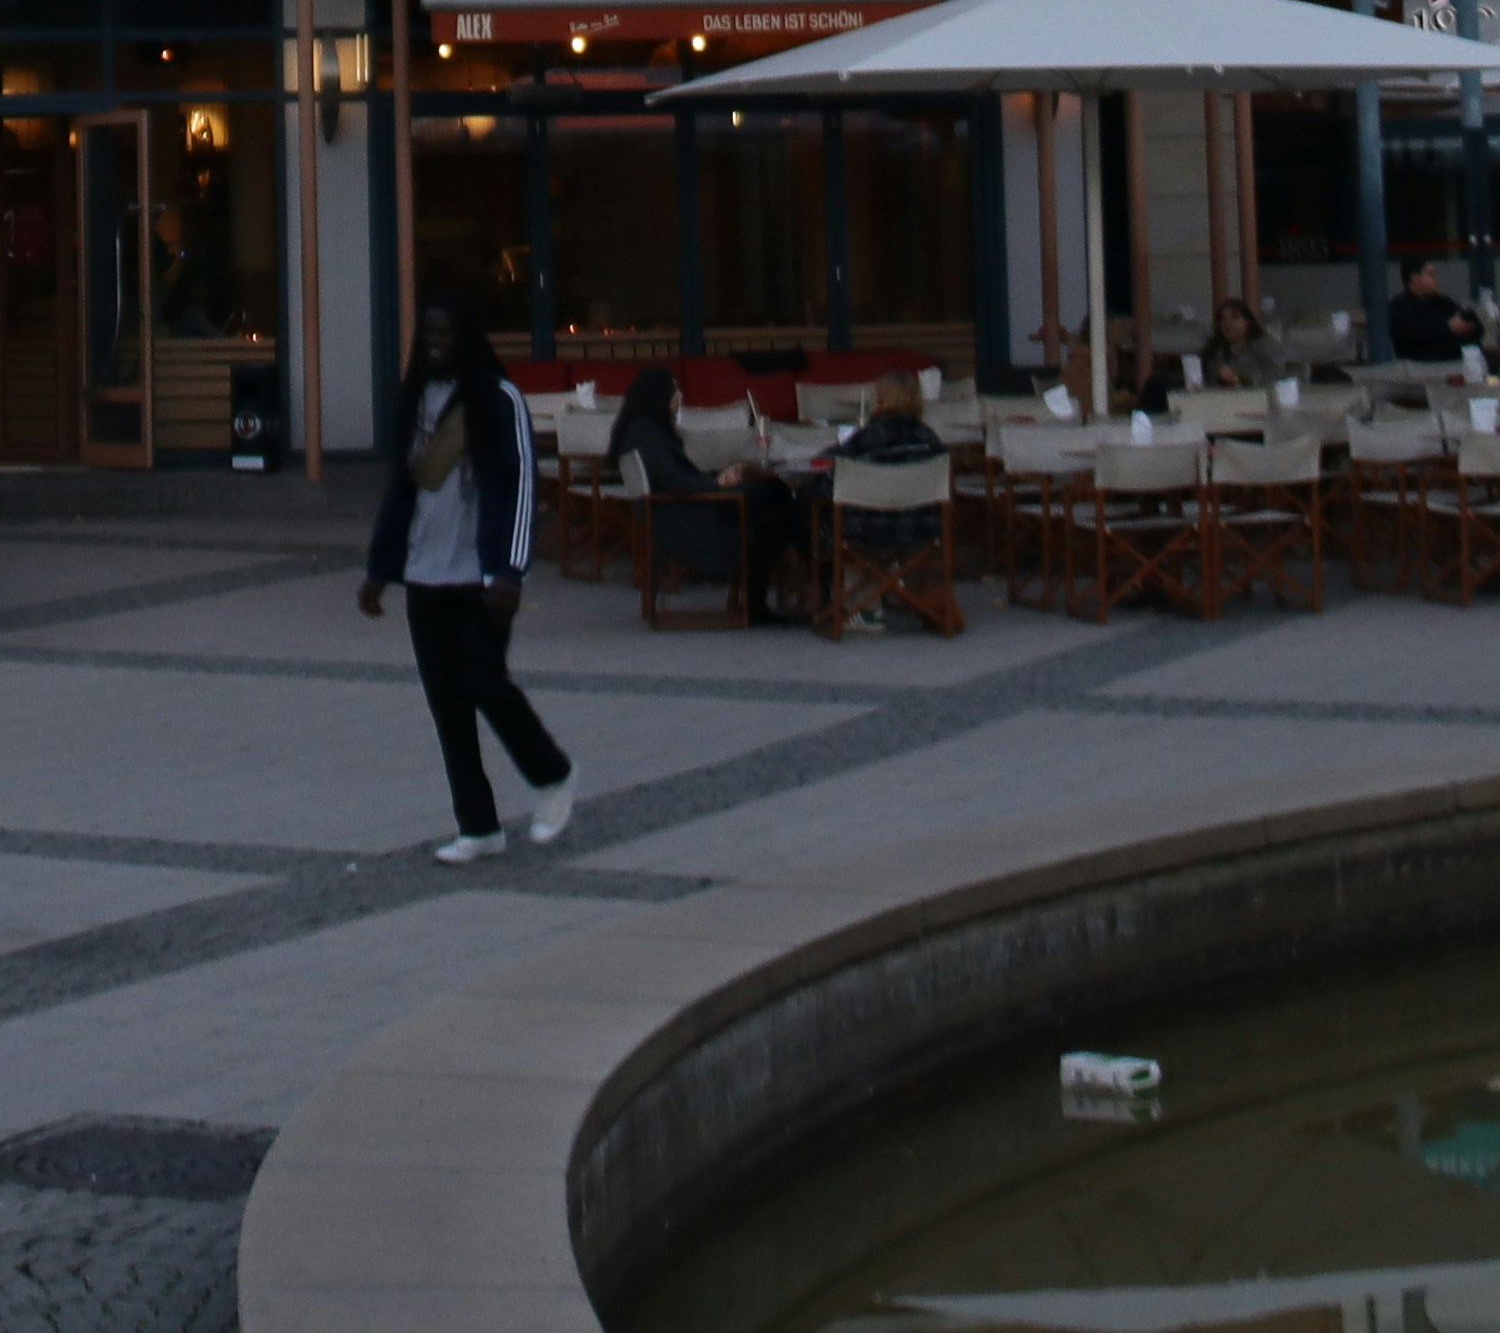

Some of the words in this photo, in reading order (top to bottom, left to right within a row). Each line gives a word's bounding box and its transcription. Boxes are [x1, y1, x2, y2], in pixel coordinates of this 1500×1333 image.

[456, 13, 492, 40] ALEX
[703, 15, 731, 31] DAS
[735, 14, 781, 30] LEBEN
[784, 13, 805, 29] IST
[809, 9, 863, 29] SCHÖN!
